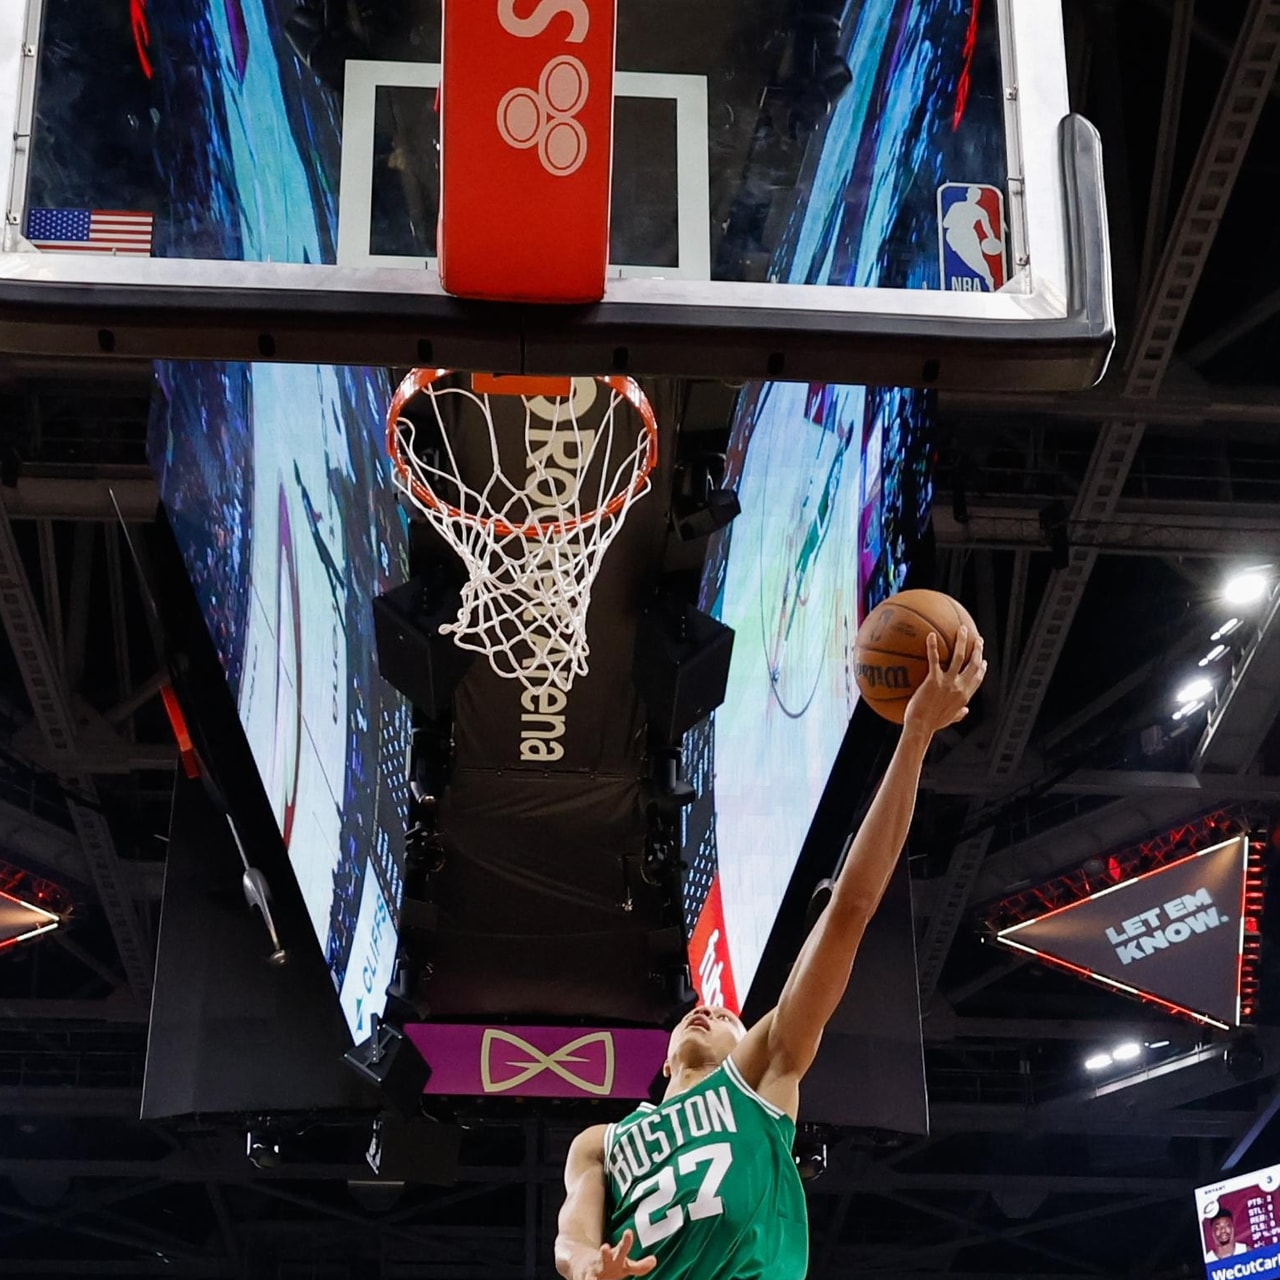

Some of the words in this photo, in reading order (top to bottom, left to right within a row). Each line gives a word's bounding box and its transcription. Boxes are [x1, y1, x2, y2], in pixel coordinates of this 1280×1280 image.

[361, 893, 388, 993] CLIFFS
[1105, 907, 1161, 945] LET
[1163, 887, 1213, 920] EM
[1115, 906, 1230, 965] KNOW.
[630, 1142, 733, 1249] 27
